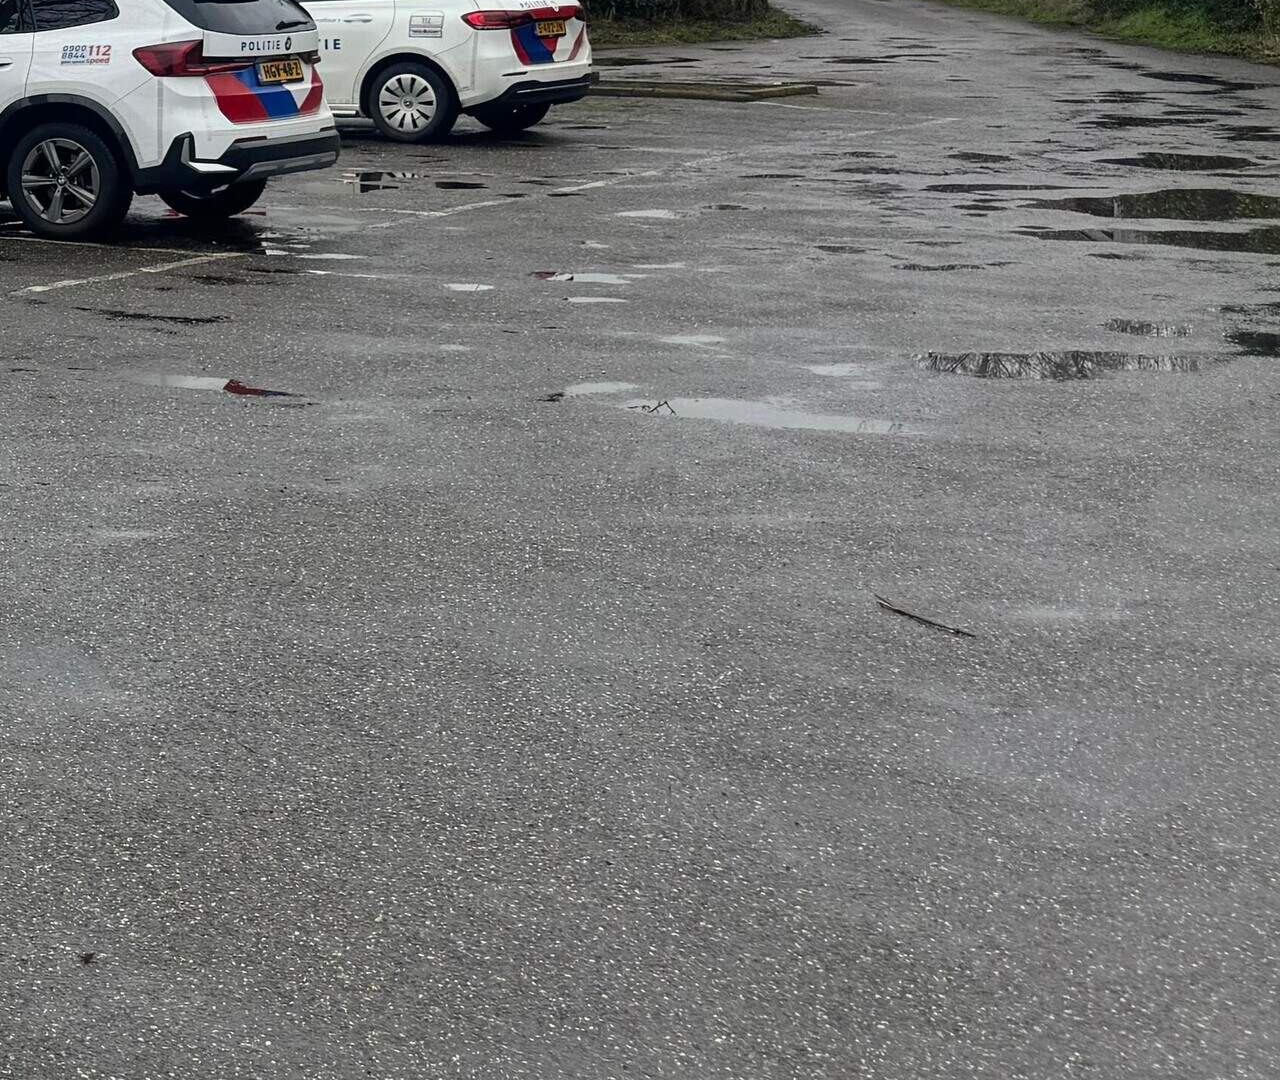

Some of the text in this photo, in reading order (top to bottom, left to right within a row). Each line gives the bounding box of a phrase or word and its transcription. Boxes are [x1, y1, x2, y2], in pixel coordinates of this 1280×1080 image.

[62, 44, 87, 52] 0900
[88, 44, 112, 56] 112
[241, 40, 281, 51] POLITIE
